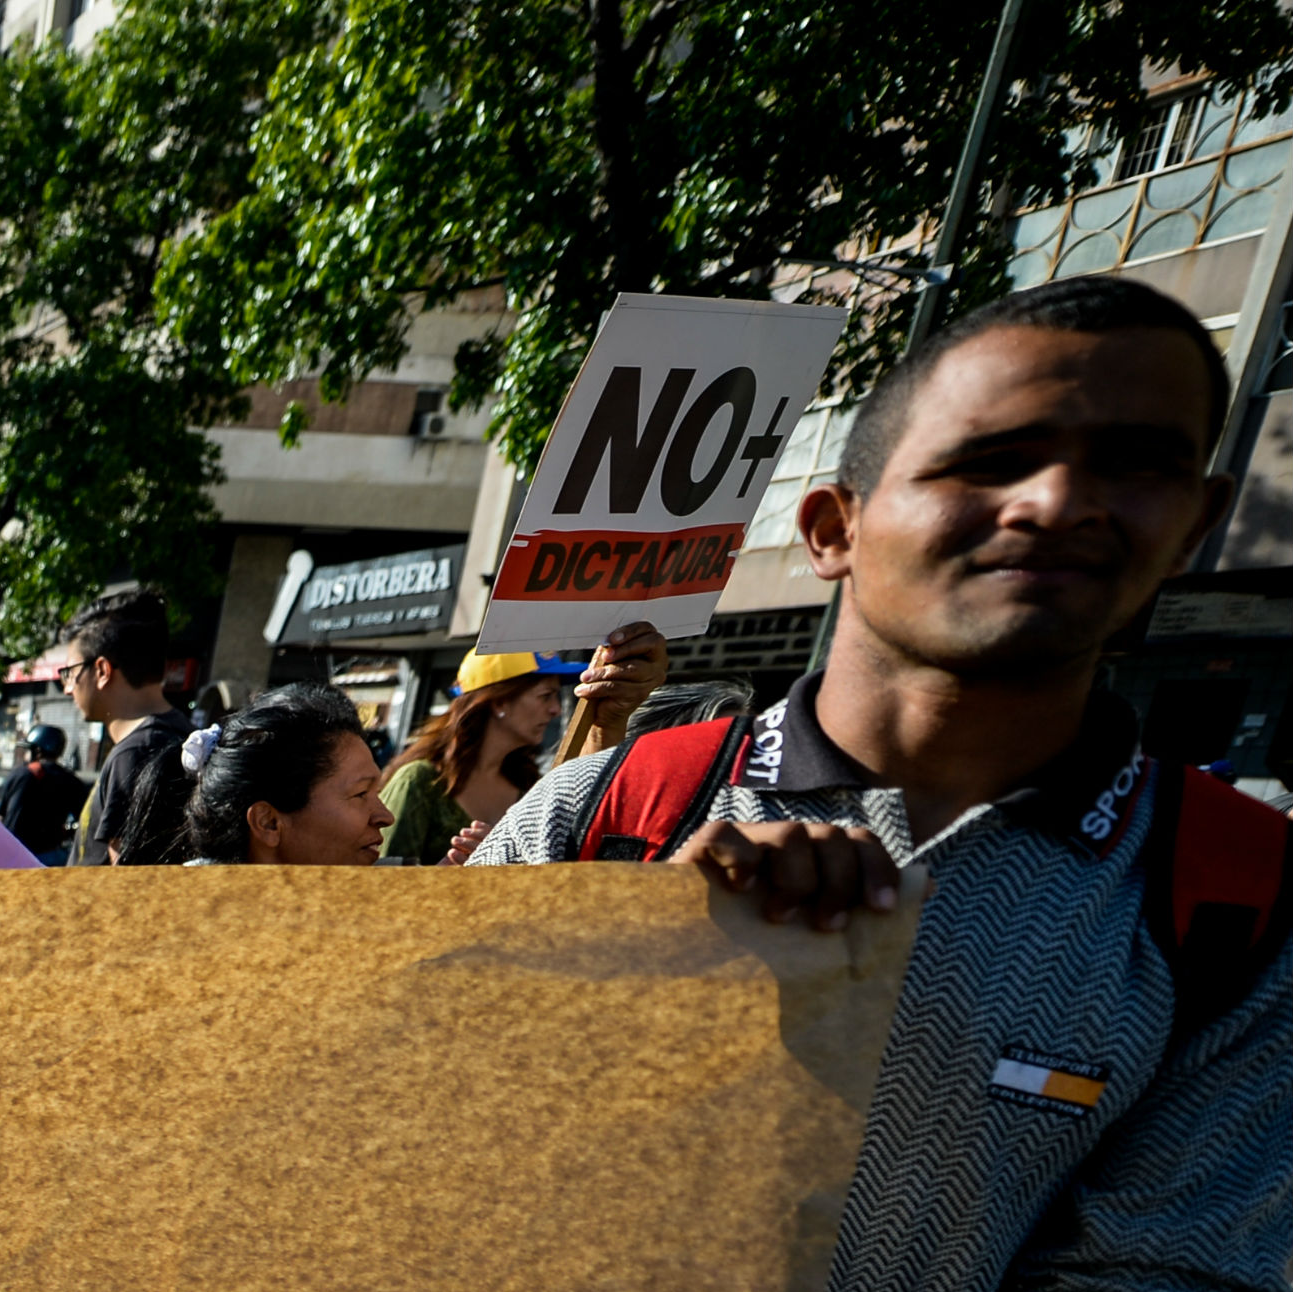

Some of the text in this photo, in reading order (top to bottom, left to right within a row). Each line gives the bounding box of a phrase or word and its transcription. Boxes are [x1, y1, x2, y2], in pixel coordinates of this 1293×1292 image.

[306, 557, 452, 611] DISTORBERA
[523, 532, 735, 593] DICTADURA
[746, 698, 789, 785] PORT
